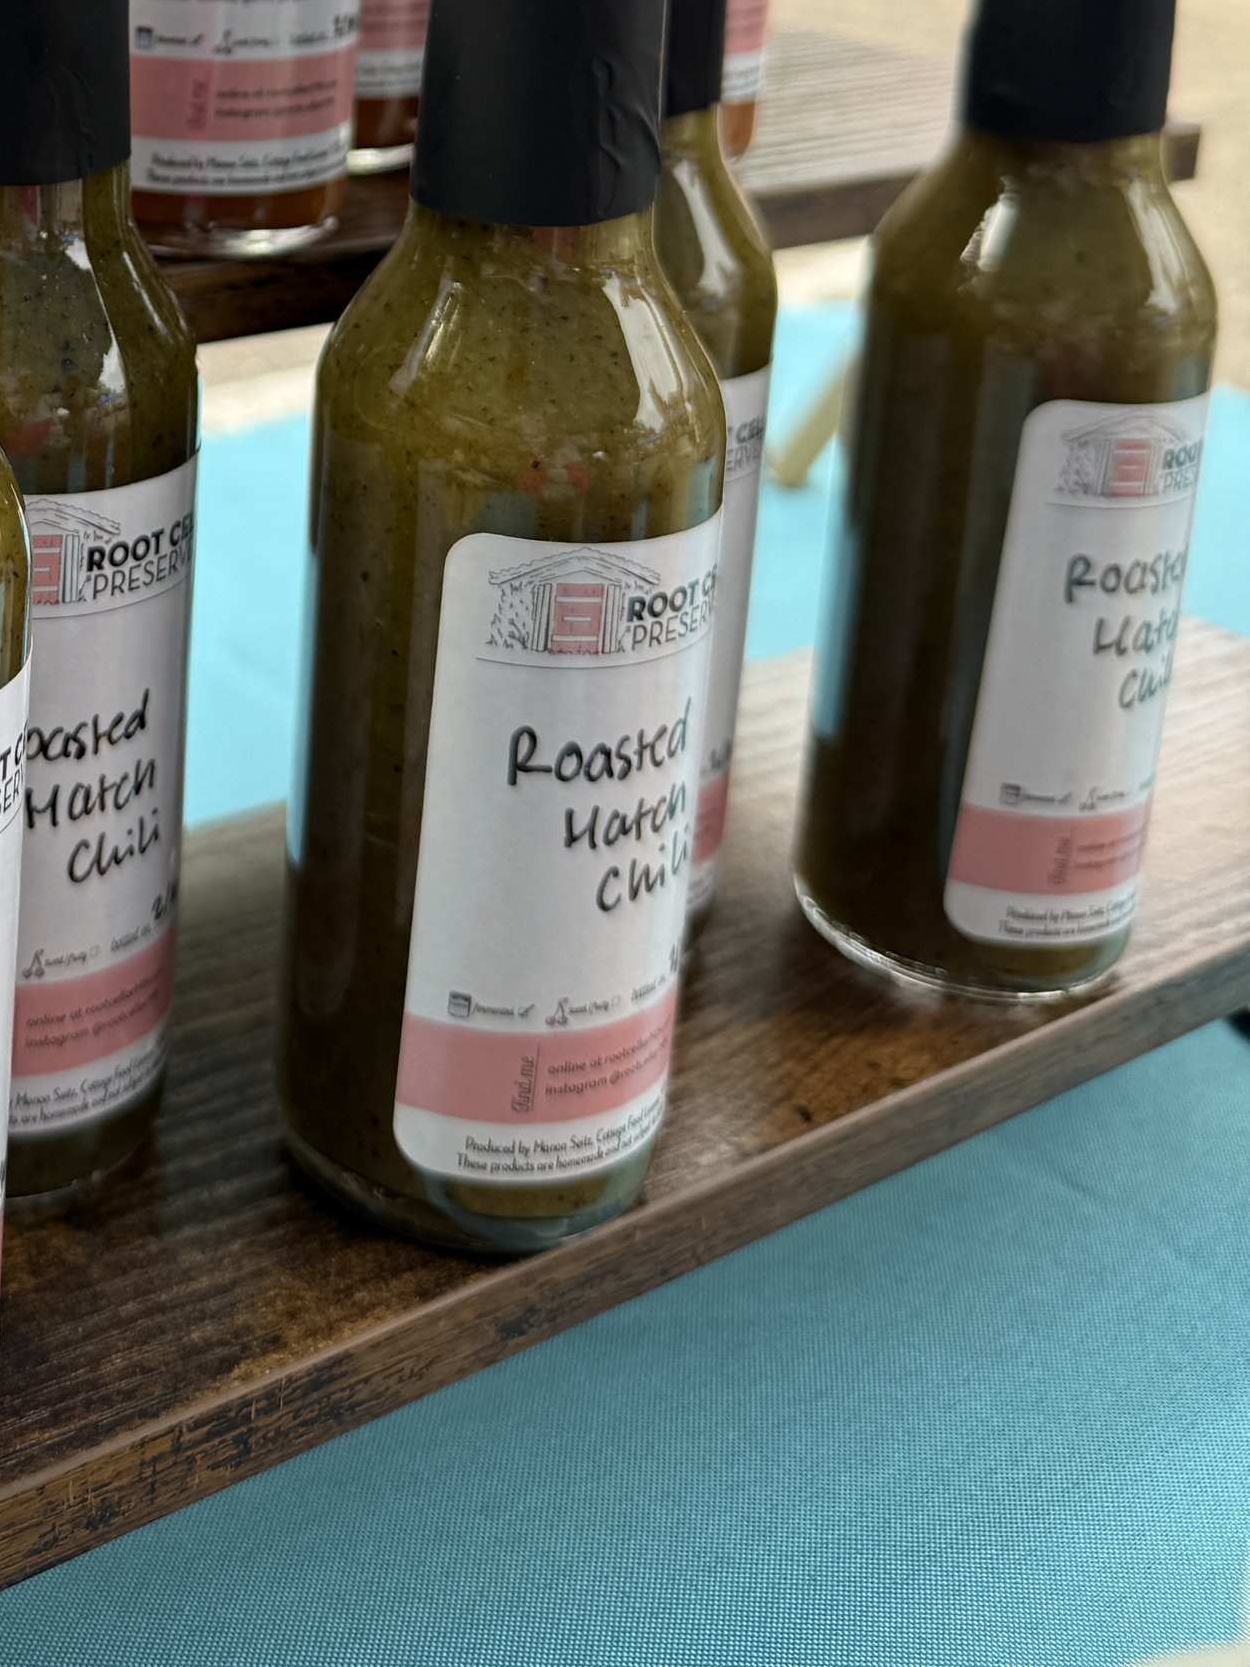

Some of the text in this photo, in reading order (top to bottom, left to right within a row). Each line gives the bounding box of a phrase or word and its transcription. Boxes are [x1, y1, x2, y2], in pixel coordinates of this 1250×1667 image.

[1162, 442, 1199, 471] ROO
[87, 527, 165, 572] ROOT
[626, 581, 696, 624] ROOT
[27, 687, 150, 762] oasted
[507, 696, 691, 786] Roasted
[25, 758, 156, 830] Hatch
[563, 781, 686, 850] Hatch
[67, 807, 160, 884] Chili
[596, 822, 690, 912] Chili
[544, 1077, 608, 1097] instagram
[547, 1056, 603, 1076] online at
[457, 1149, 605, 1174] These products are homemade
[466, 1136, 515, 1155] Produced
[518, 1137, 530, 1157] by
[534, 1140, 567, 1155] Manon
